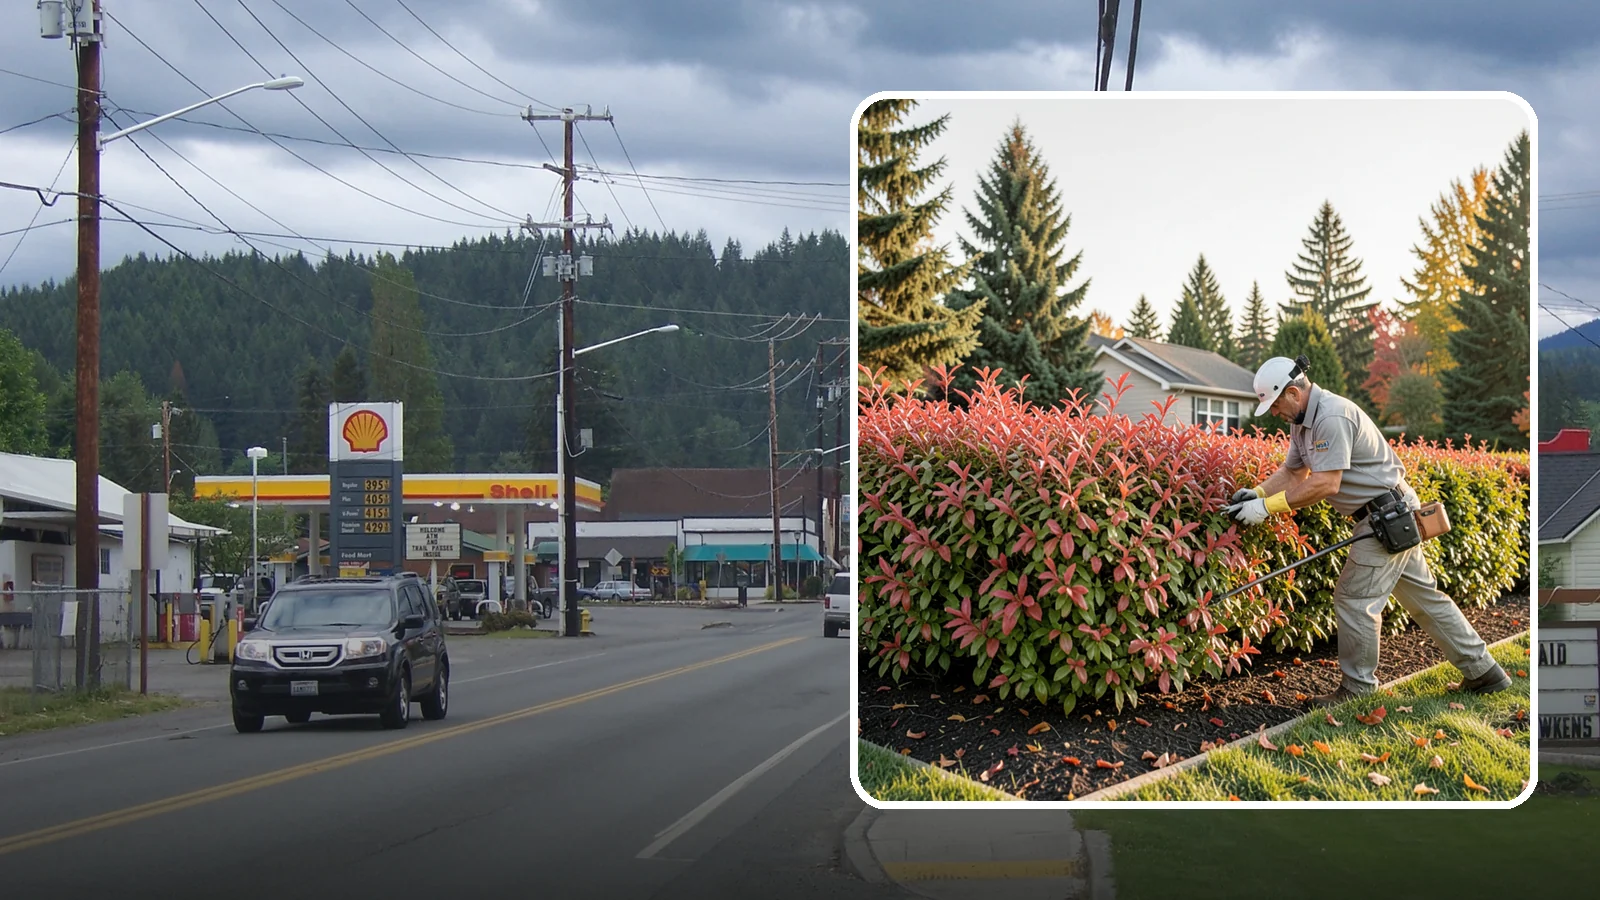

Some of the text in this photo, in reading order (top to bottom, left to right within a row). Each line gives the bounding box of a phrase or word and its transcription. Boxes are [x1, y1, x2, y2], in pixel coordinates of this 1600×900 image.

[365, 480, 383, 490] 395
[490, 484, 547, 498] Shell
[365, 494, 383, 504] 405
[365, 508, 383, 518] 415
[365, 522, 383, 532] 429
